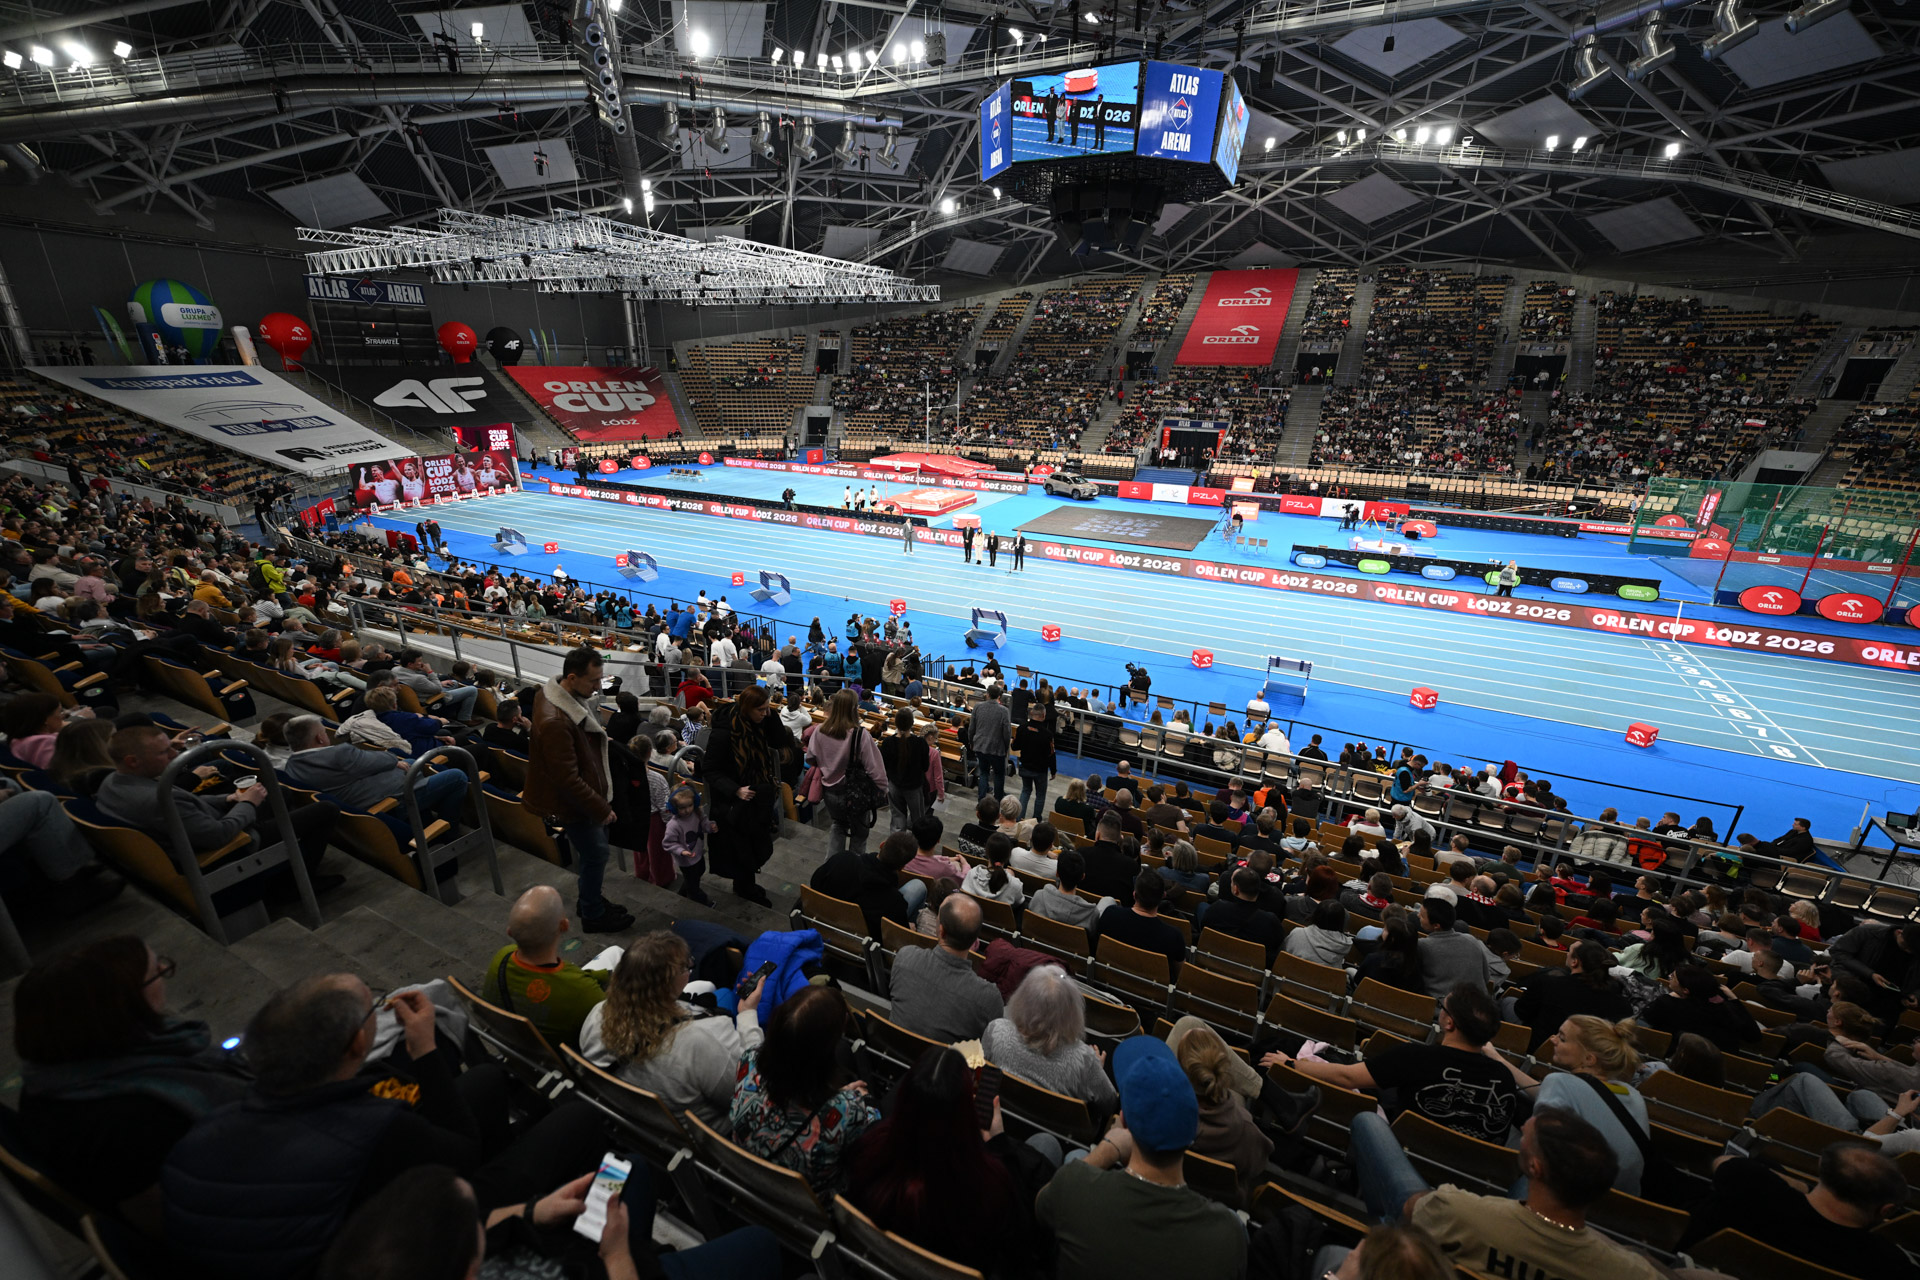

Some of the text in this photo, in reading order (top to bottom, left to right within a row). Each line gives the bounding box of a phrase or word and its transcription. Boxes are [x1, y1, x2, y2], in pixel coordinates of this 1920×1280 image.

[1169, 73, 1200, 96] ATLAS
[1013, 100, 1044, 114] ORLEN
[1104, 109, 1131, 122] 026
[1160, 131, 1191, 152] ARENA
[308, 277, 424, 304] ATLAS ATLAS ARENA
[1221, 298, 1268, 306] ORLEN
[179, 307, 206, 315] GRUPA
[181, 313, 212, 322] LUXMED
[365, 336, 400, 345] STRAMATEL
[504, 340, 520, 350] 4F
[104, 375, 250, 390] Aquapark FALA
[543, 381, 649, 393] ORLEN
[372, 376, 488, 414] 4F
[552, 393, 656, 412] CUP
[601, 418, 640, 426] ŁÓDŹ
[489, 434, 509, 442] CUP
[424, 458, 451, 468] ORLEN
[426, 465, 453, 478] CUP
[791, 464, 810, 472] ORLEN
[823, 467, 838, 475] ŁÓDŹ
[839, 469, 857, 477] 2026
[863, 471, 884, 480] ORLEN
[897, 473, 915, 482] ŁÓDŹ
[428, 475, 455, 486] ŁÓDŹ
[942, 478, 1023, 492] ORLEN CUP ŁÓDŹ 2026
[430, 483, 457, 493] 2026
[551, 485, 620, 500] ORLEN CUP ŁÓDŹ 2026
[1193, 492, 1219, 500] PZLA
[371, 504, 377, 512] 8
[626, 494, 647, 503] ORLEN
[647, 496, 660, 505] CUP
[681, 501, 704, 511] 2026
[1286, 500, 1315, 510] PZLA
[710, 504, 798, 523] ORLEN CUP ŁÓDŹ 2026
[806, 516, 833, 528] ORLEN
[834, 519, 850, 530] CUP
[853, 522, 877, 533] ŁÓDŹ
[916, 530, 948, 542] ORLEN
[1044, 546, 1182, 572] ORLEN CUP ŁÓDŹ 2026
[1195, 564, 1358, 594] ORLEN CUP ŁÓDŹ 2026
[1375, 586, 1572, 621] ORLEN CUP ŁÓDŹ 2026
[1757, 602, 1783, 610] ORLEN
[1836, 610, 1863, 618] ORLEN
[1592, 613, 1836, 655] ORLEN CUP ŁÓDŹ 2026
[1655, 643, 1671, 651] 1
[1668, 654, 1688, 663] 2
[1681, 665, 1701, 676] 3
[1698, 679, 1718, 689] 4
[1711, 692, 1735, 704] 5
[1727, 708, 1752, 720] 6
[1746, 724, 1768, 738] 7
[1626, 737, 1645, 746] ORLEN
[1768, 743, 1798, 759] 8
